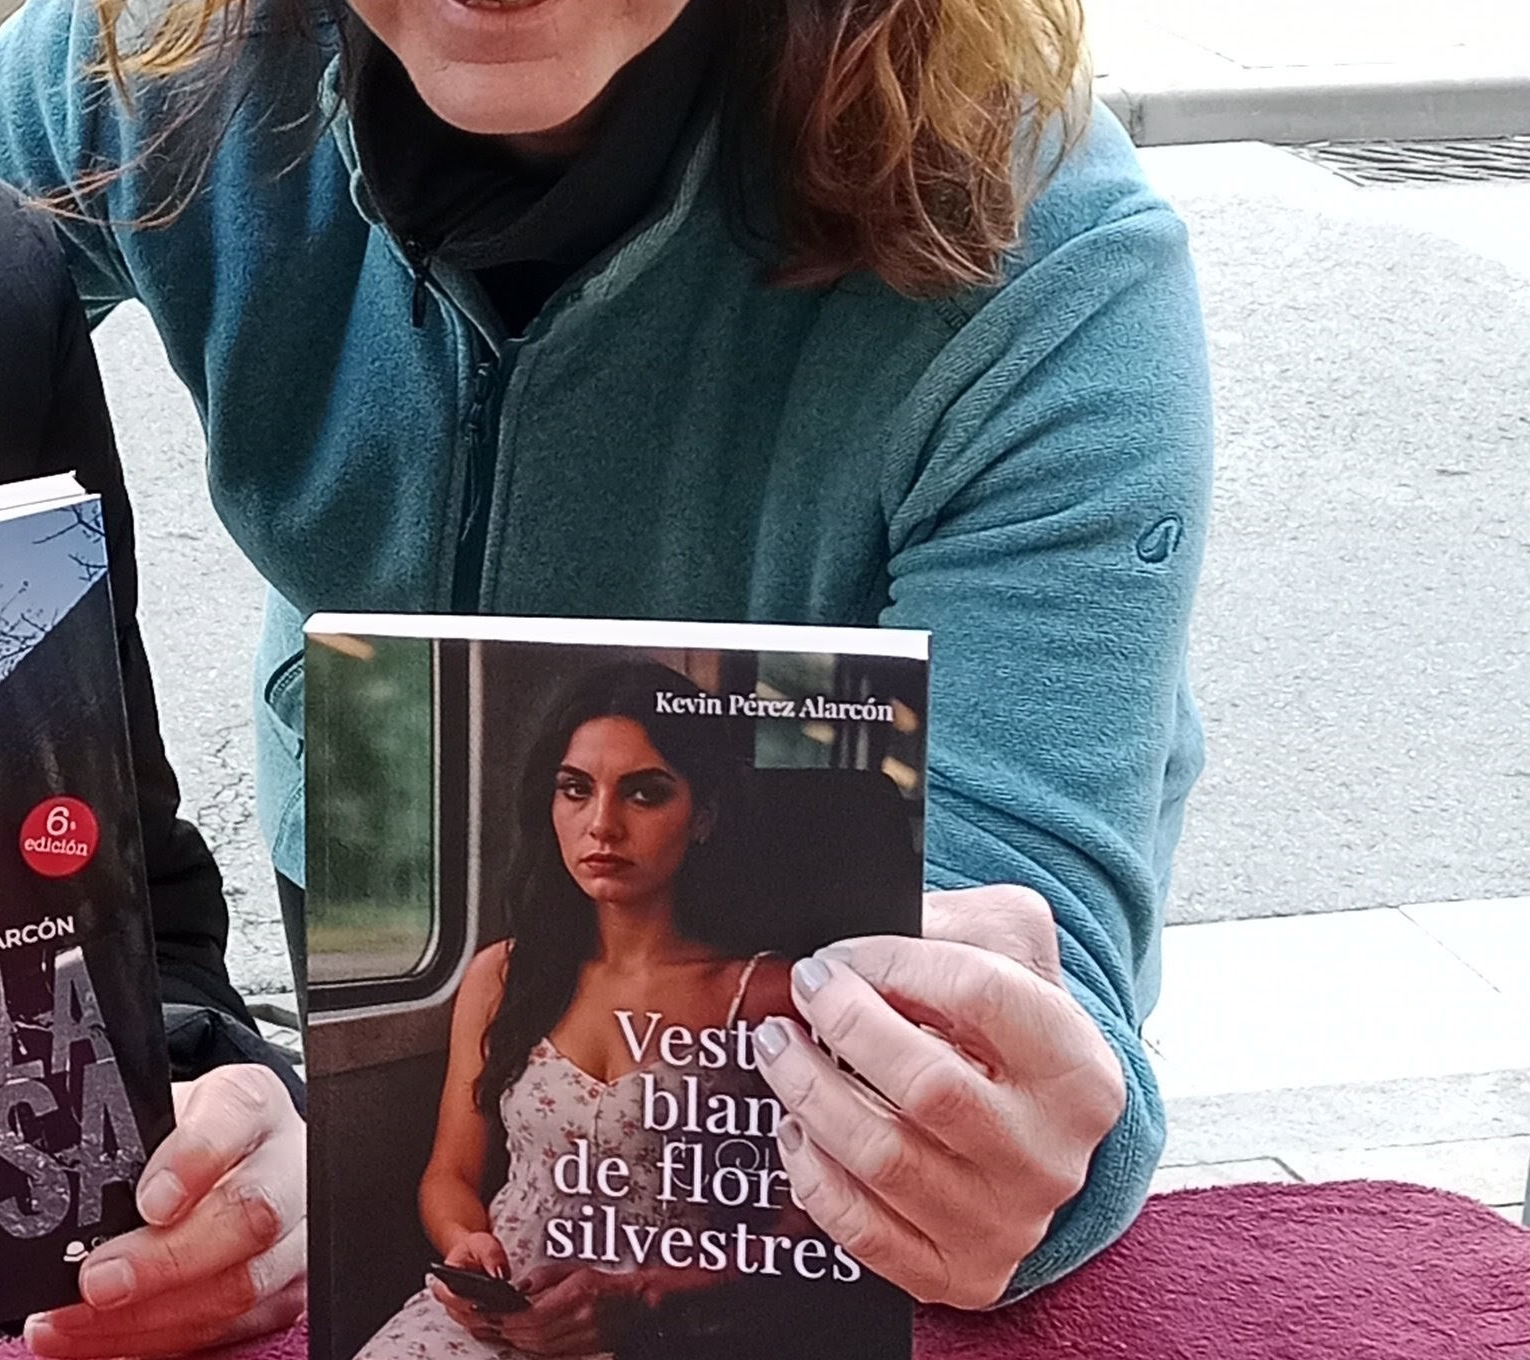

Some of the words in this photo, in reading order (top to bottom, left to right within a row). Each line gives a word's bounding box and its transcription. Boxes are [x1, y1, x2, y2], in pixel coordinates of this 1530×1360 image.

[654, 692, 723, 715] Kevin
[728, 693, 796, 718] Pérez
[798, 696, 894, 722] Alarcón
[24, 836, 88, 857] edición
[613, 1010, 760, 1070] Vest
[639, 1073, 781, 1138] blan
[553, 1139, 631, 1197] de
[656, 1142, 806, 1211] flor
[545, 1203, 862, 1283] silvestres
